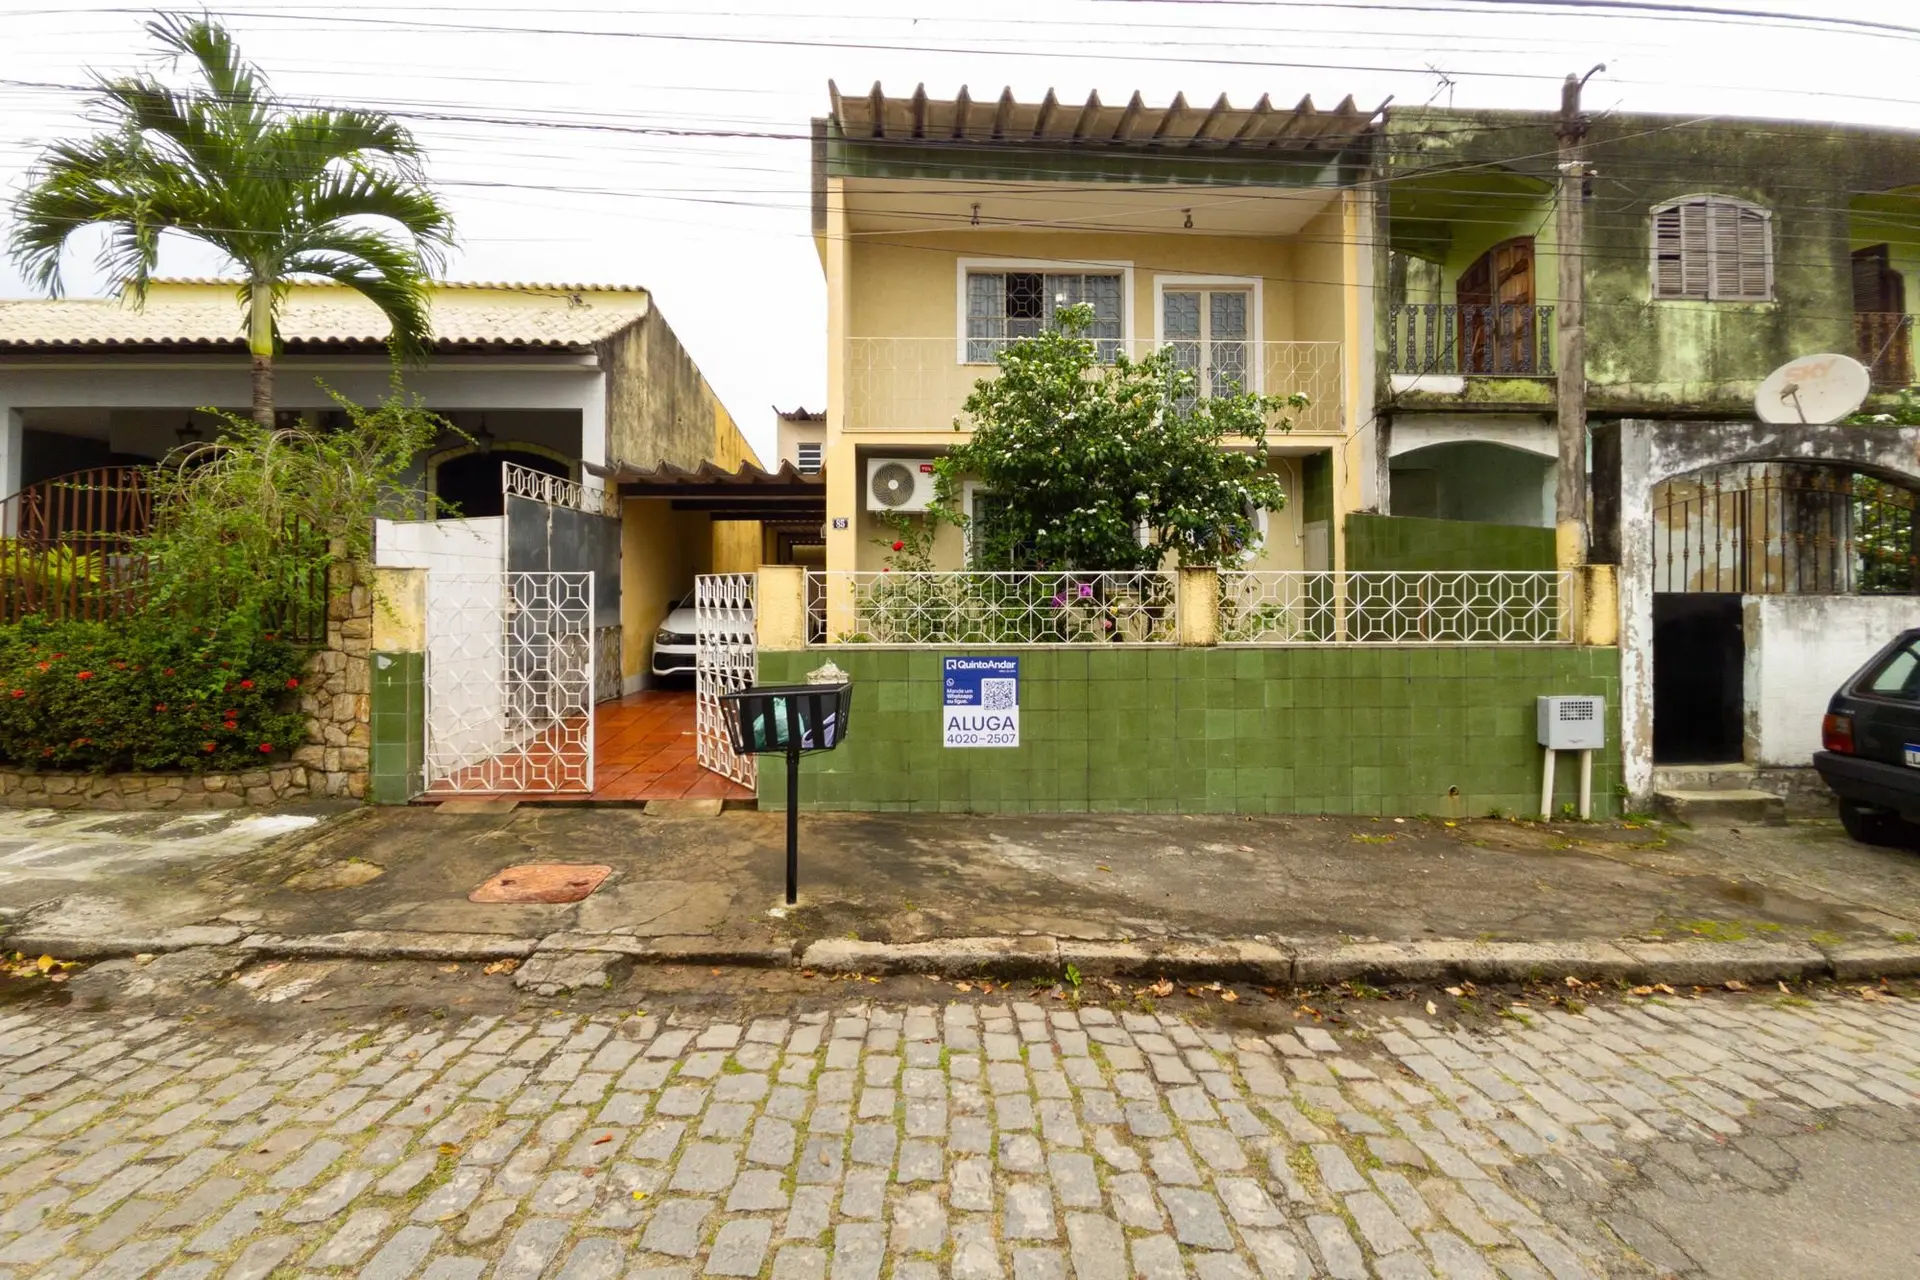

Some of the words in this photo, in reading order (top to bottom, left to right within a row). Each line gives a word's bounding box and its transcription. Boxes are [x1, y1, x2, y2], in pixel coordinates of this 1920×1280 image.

[957, 660, 1016, 669] QuintoAndar
[947, 716, 1016, 732] ALUGA
[947, 733, 1016, 744] 4020-2507
